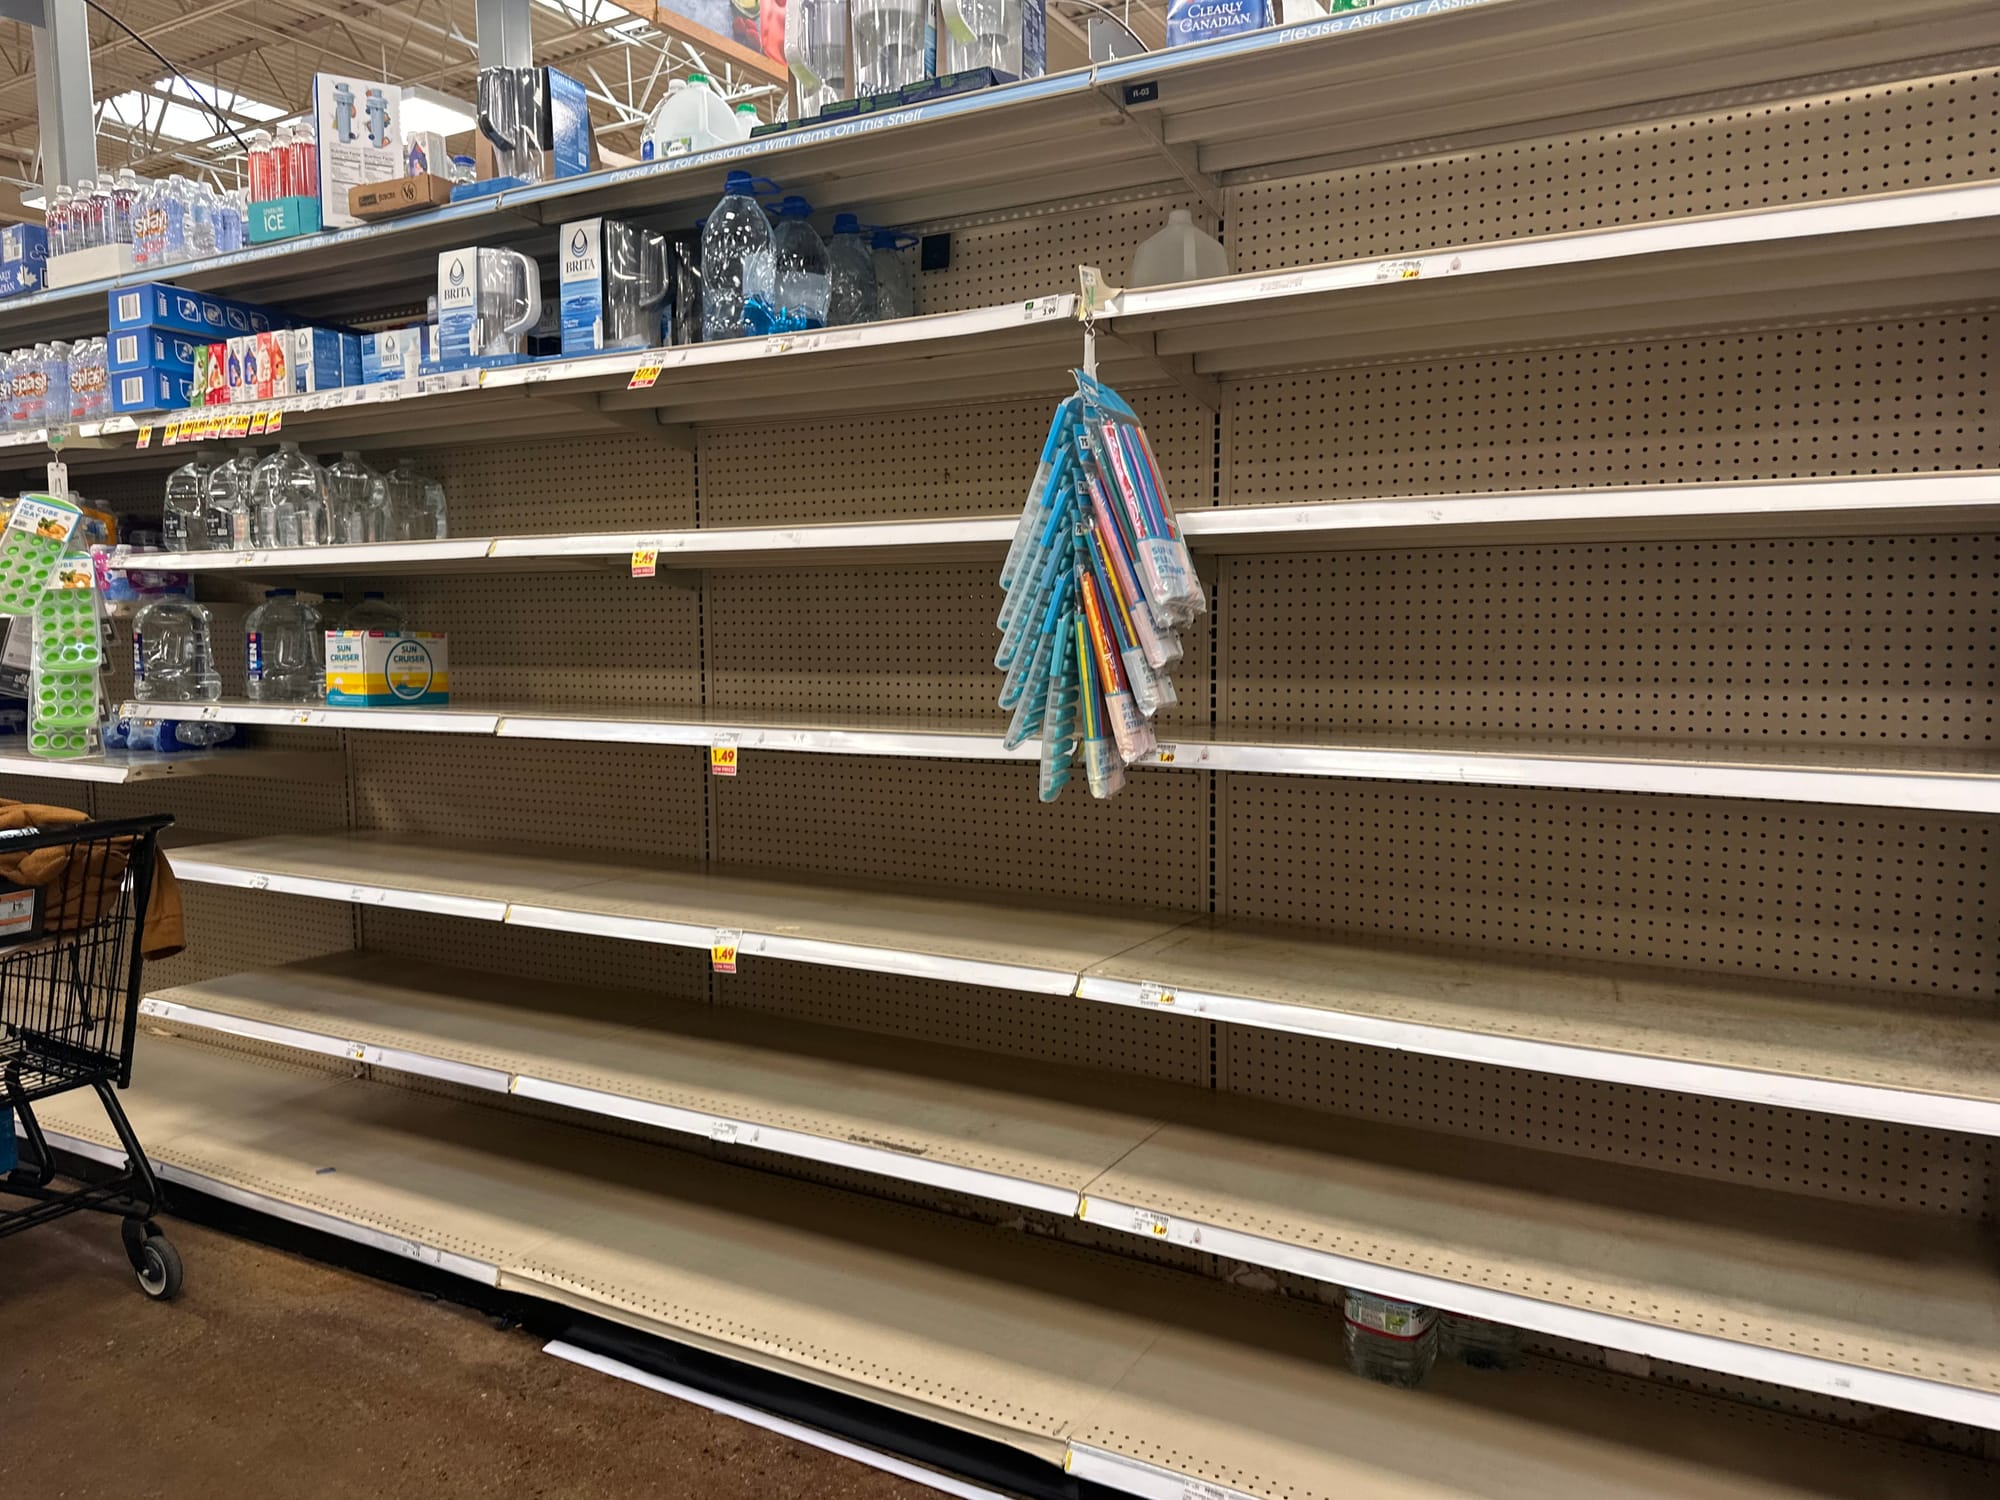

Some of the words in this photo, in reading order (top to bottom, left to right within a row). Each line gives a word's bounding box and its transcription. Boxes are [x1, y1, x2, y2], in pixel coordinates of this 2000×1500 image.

[1188, 2, 1243, 18] CLEARLY
[1180, 13, 1250, 32] CANADIAN
[1280, 22, 1343, 43] Please
[1349, 15, 1382, 30] Ask
[1390, 5, 1419, 21] For
[610, 167, 647, 182] Please
[651, 162, 670, 174] Ask
[674, 158, 693, 169] For
[695, 144, 760, 165] Assistance
[765, 137, 791, 150] With
[795, 128, 830, 145] Items
[834, 124, 855, 137] On
[860, 118, 884, 132] This
[888, 108, 923, 126] Shelf
[264, 213, 286, 232] ICE
[566, 258, 595, 273] BRITA
[444, 287, 471, 300] BRITA
[19, 508, 39, 518] TRAY
[37, 505, 59, 517] CUBE
[401, 645, 416, 653] SUN
[330, 653, 359, 662] CRUISER
[393, 655, 424, 663] CRUISER
[713, 750, 735, 762] 1.49
[714, 947, 734, 960] 1.49
